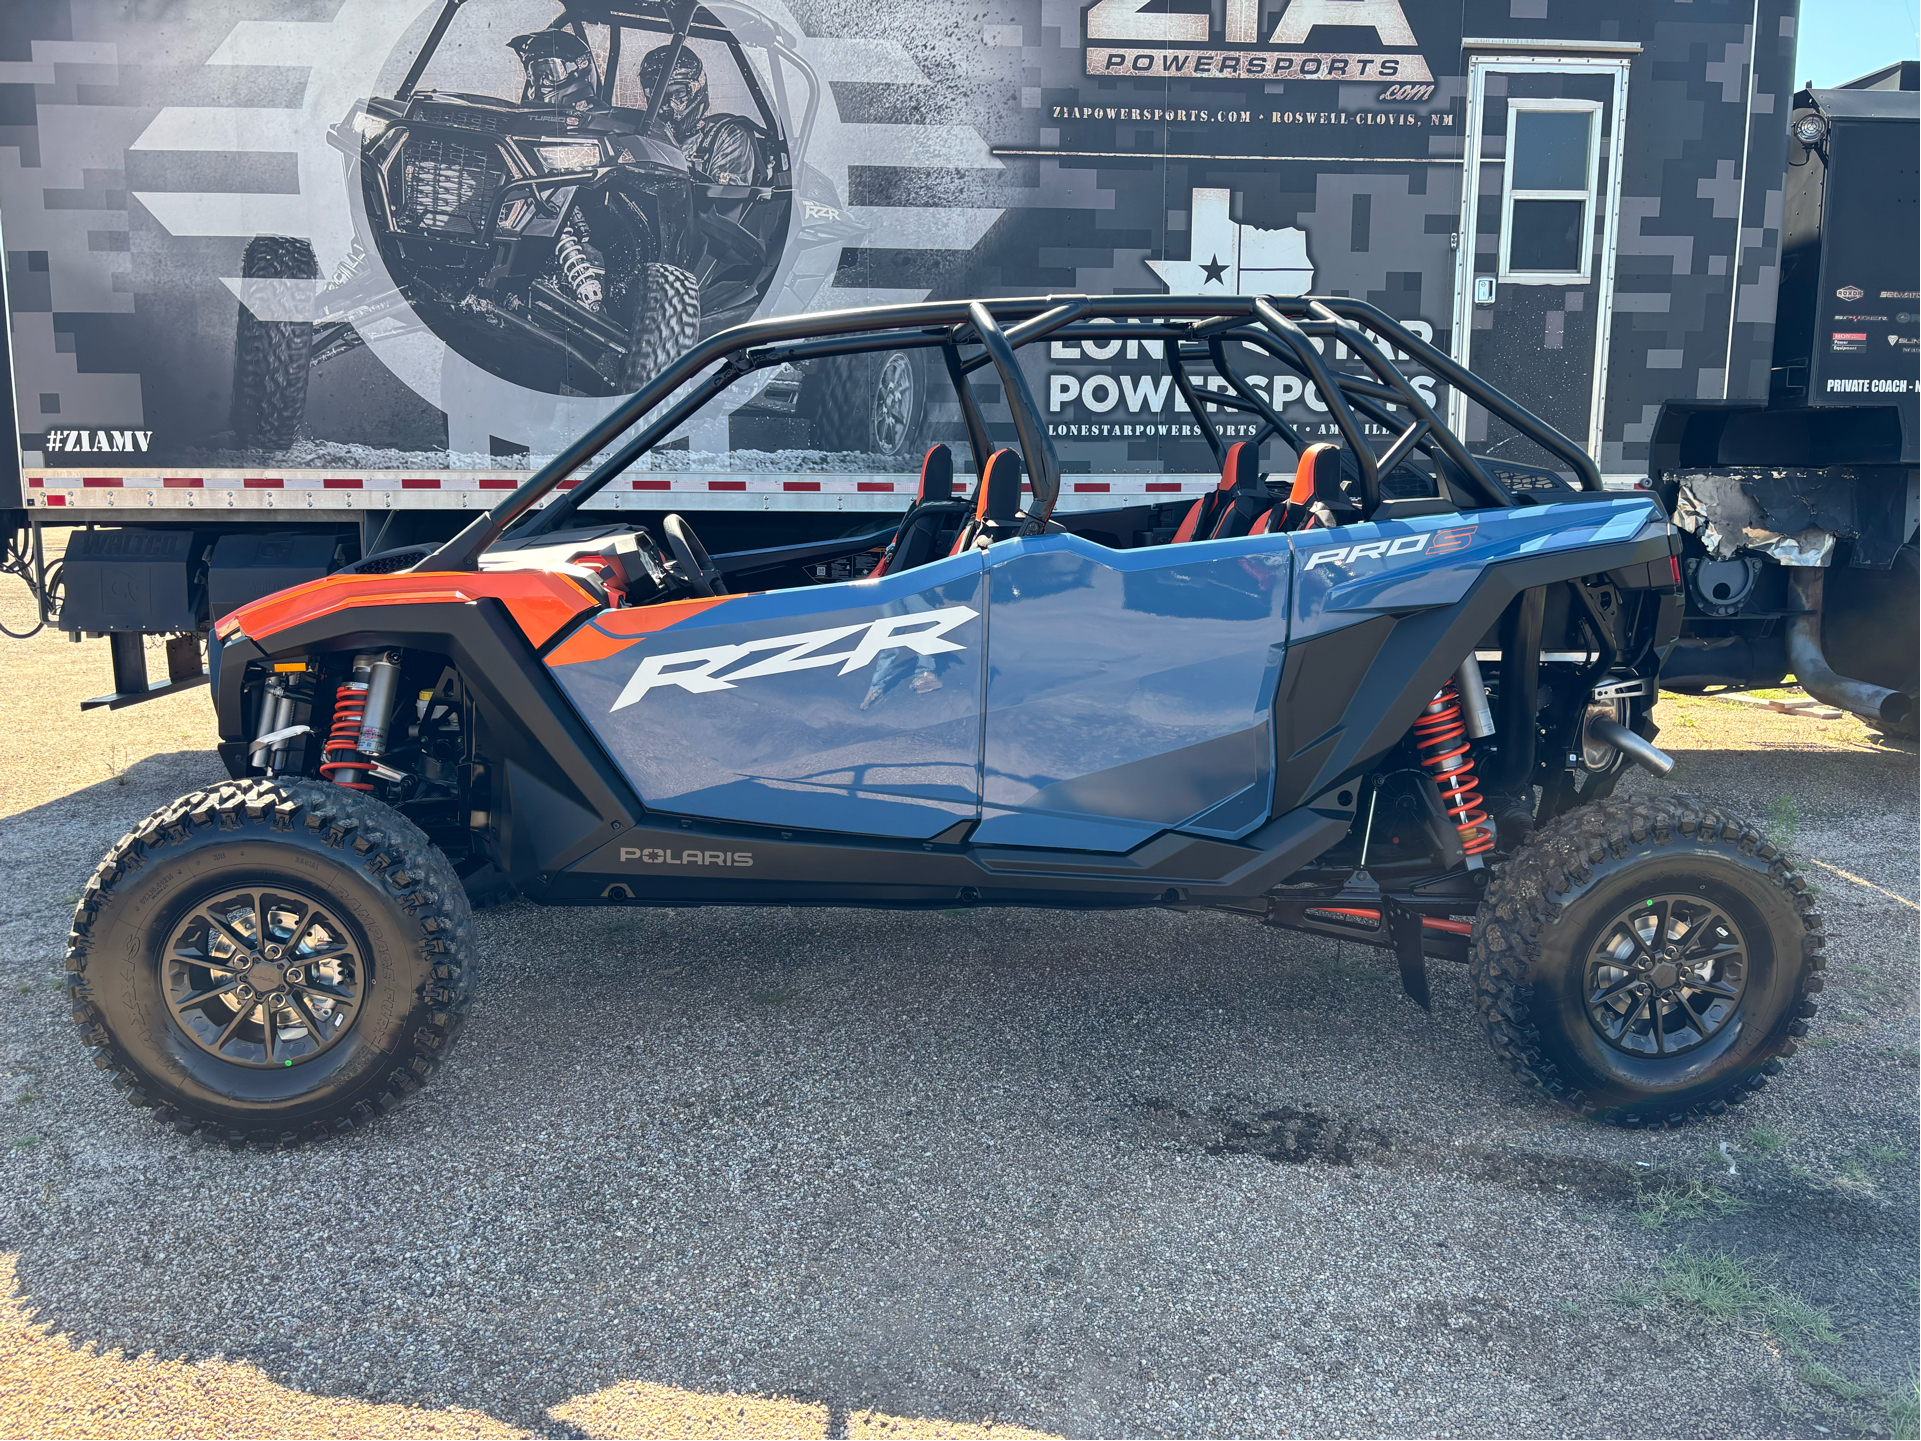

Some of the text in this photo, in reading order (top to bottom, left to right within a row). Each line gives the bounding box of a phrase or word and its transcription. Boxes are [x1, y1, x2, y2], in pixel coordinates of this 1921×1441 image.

[1104, 53, 1400, 77] POWERSPORTS
[1379, 84, 1435, 101] .com
[1052, 106, 1454, 127] ZIAPOWERSPORTS.COM ROSWELL-CLOVIS, NM
[804, 205, 842, 221] RZR
[1826, 379, 1870, 392] PRIVATE
[1871, 379, 1907, 393] COACH
[46, 430, 153, 452] #ZIAMV
[82, 533, 178, 557] WALTCO
[1303, 525, 1479, 571] PRO S
[608, 605, 980, 713] RZR
[619, 847, 754, 867] POLARIS
